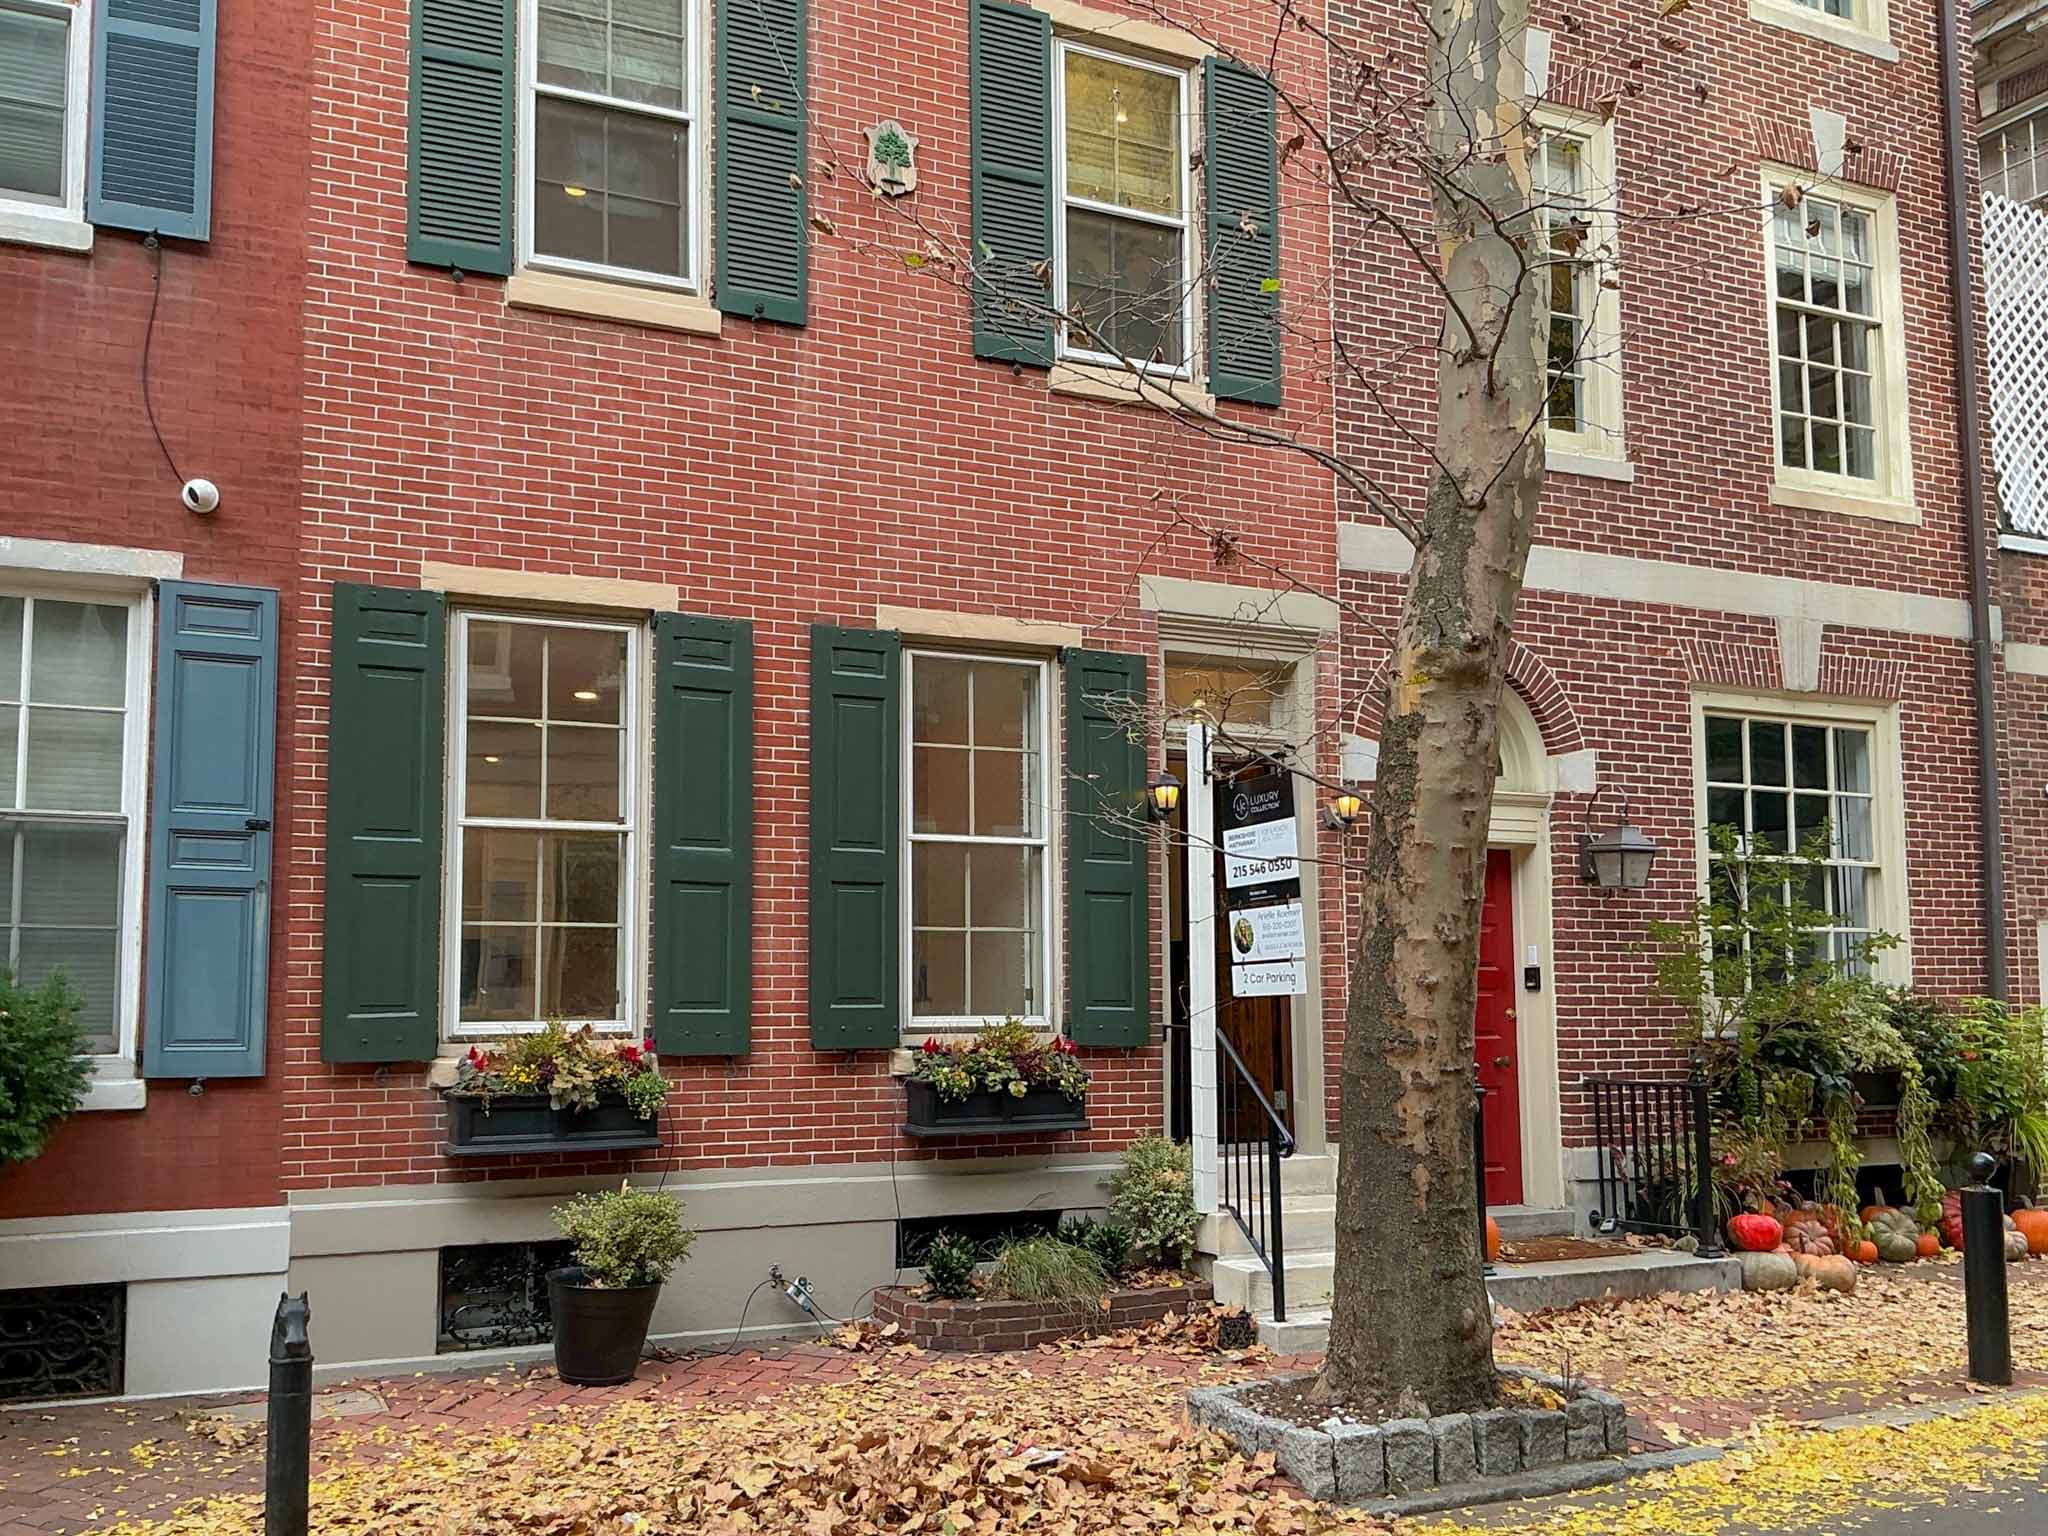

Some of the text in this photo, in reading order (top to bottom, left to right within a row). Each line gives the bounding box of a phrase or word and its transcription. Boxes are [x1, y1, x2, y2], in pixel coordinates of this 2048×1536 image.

[1250, 790, 1279, 806] LUXURY
[1250, 801, 1280, 813] COLLECTION
[1233, 858, 1292, 879] 215 546 0550
[1244, 971, 1296, 985] 2 Car Parking
